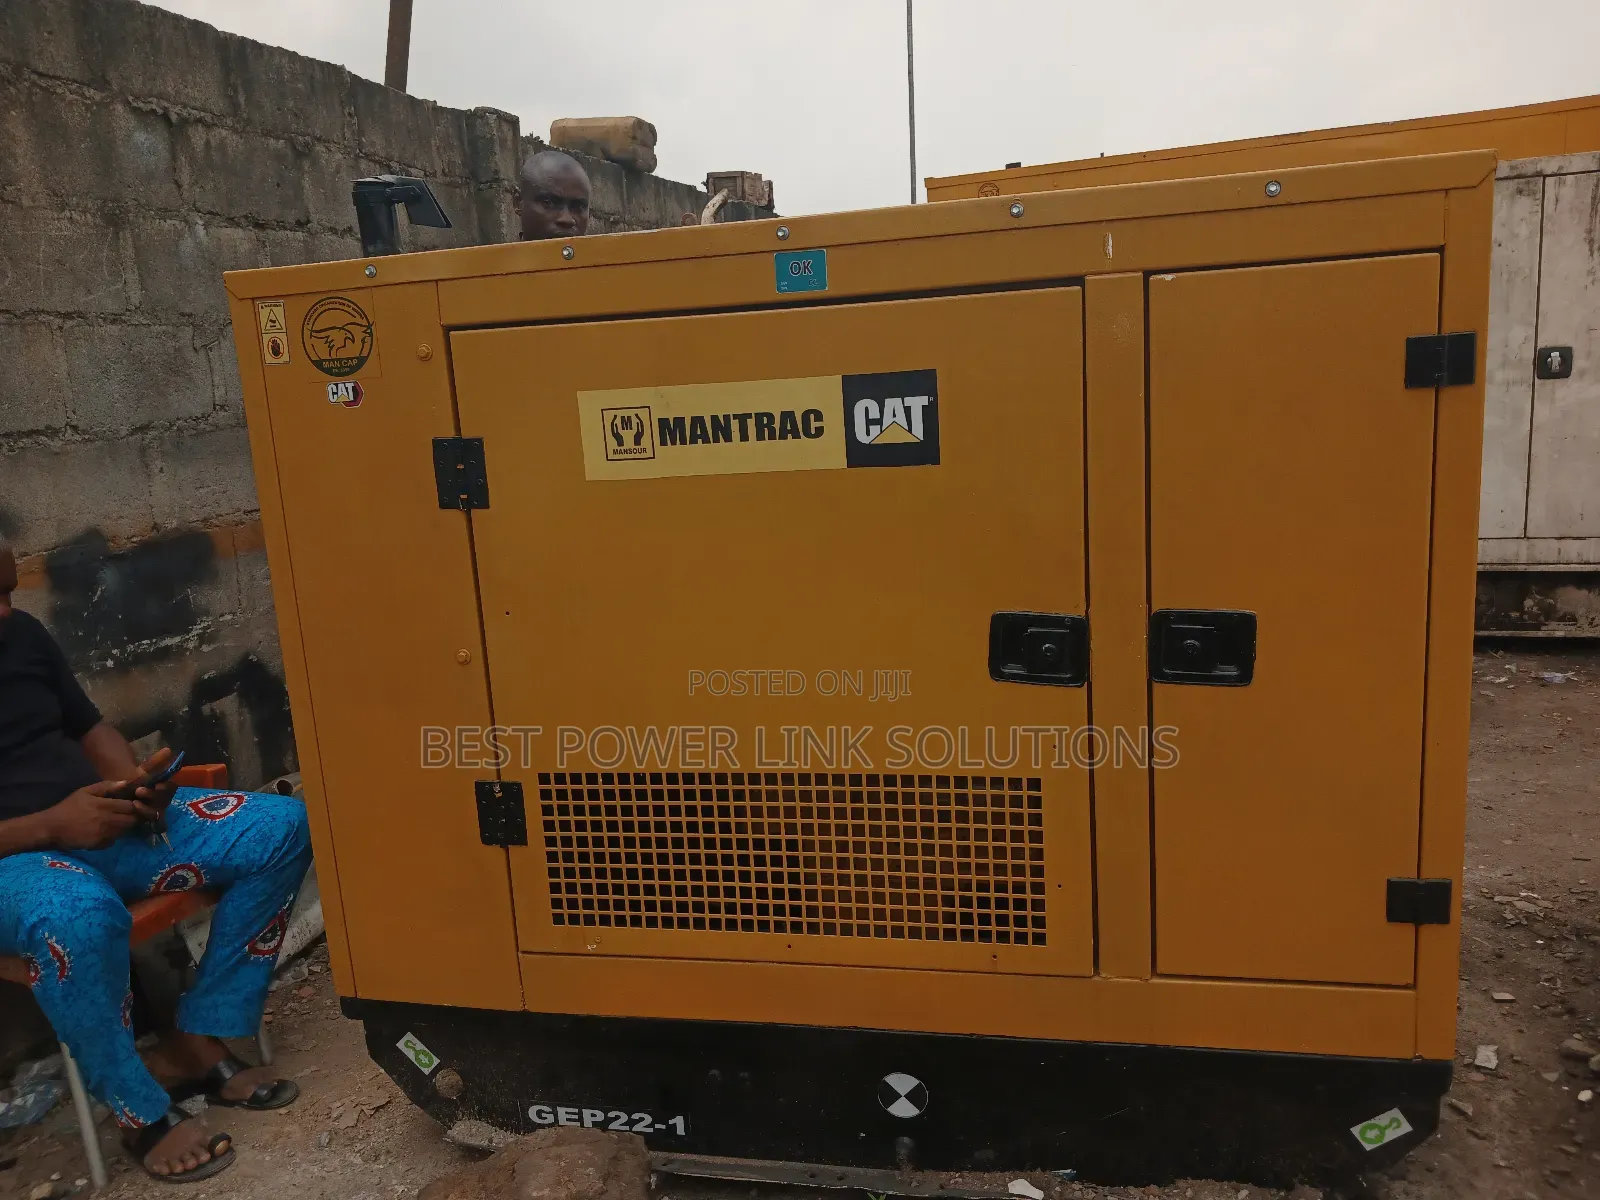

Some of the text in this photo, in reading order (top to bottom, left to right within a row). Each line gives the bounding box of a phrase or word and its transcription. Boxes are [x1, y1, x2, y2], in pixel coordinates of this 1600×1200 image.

[789, 260, 814, 277] OK
[322, 358, 358, 369] MAN CAP
[327, 382, 355, 403] CAT
[620, 415, 633, 431] M
[657, 408, 825, 447] MANTRAC
[853, 395, 929, 445] CAT
[612, 447, 648, 456] MANSOUR
[528, 1104, 686, 1136] GEP22-1
